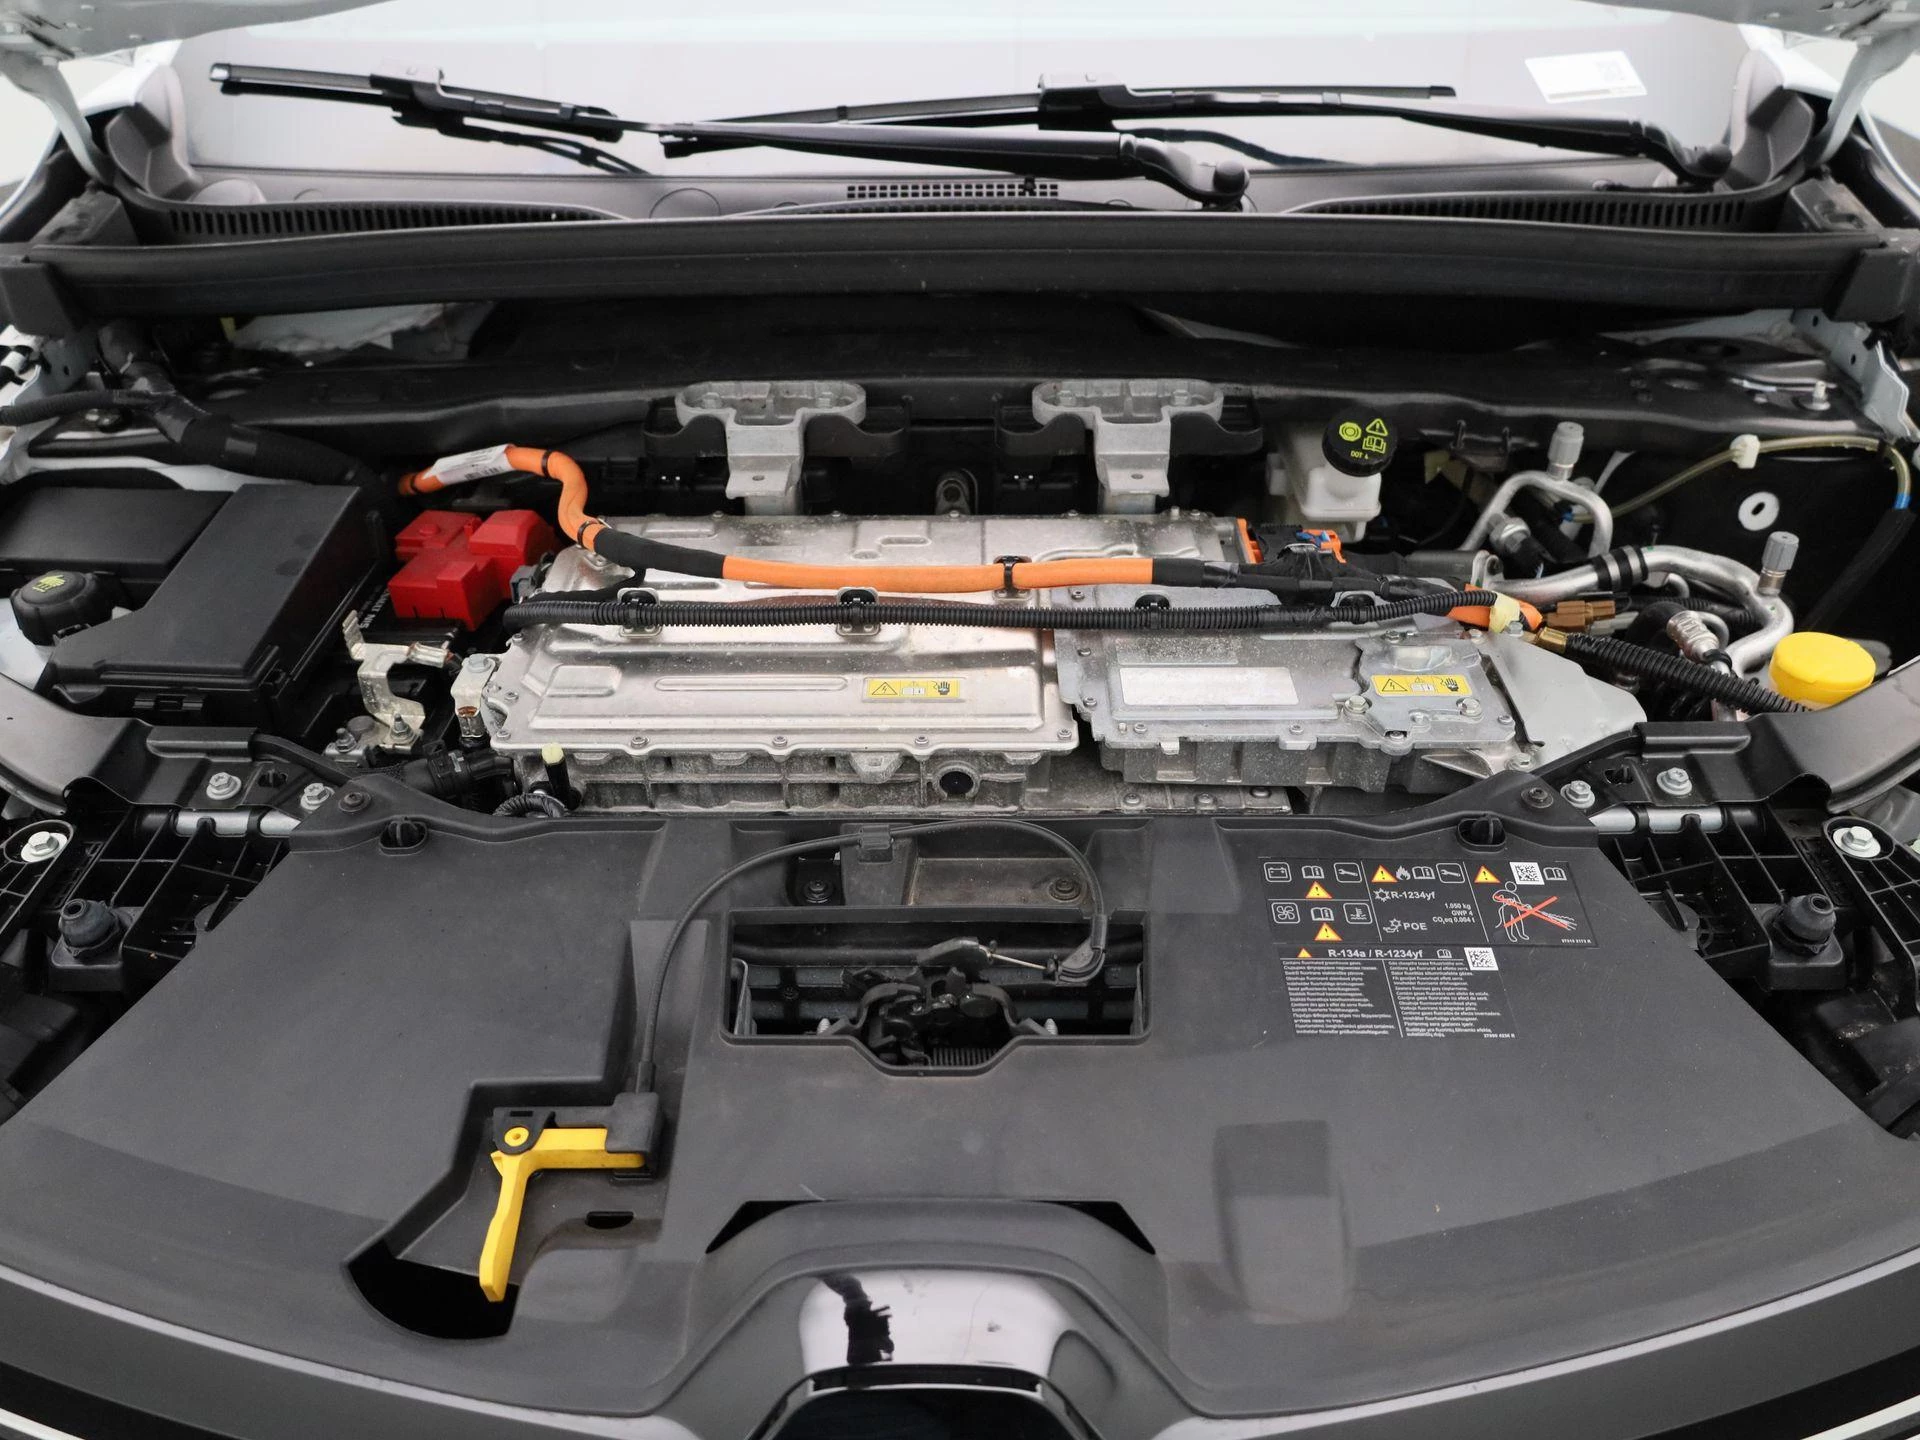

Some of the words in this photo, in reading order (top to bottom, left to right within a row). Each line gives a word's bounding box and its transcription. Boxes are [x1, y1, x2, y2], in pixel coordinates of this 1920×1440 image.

[1350, 450, 1363, 458] DOT
[1390, 891, 1436, 901] R-1234yf
[1403, 922, 1428, 931] POE
[1328, 949, 1366, 958] R-134a
[1375, 949, 1423, 959] R-1234yf
